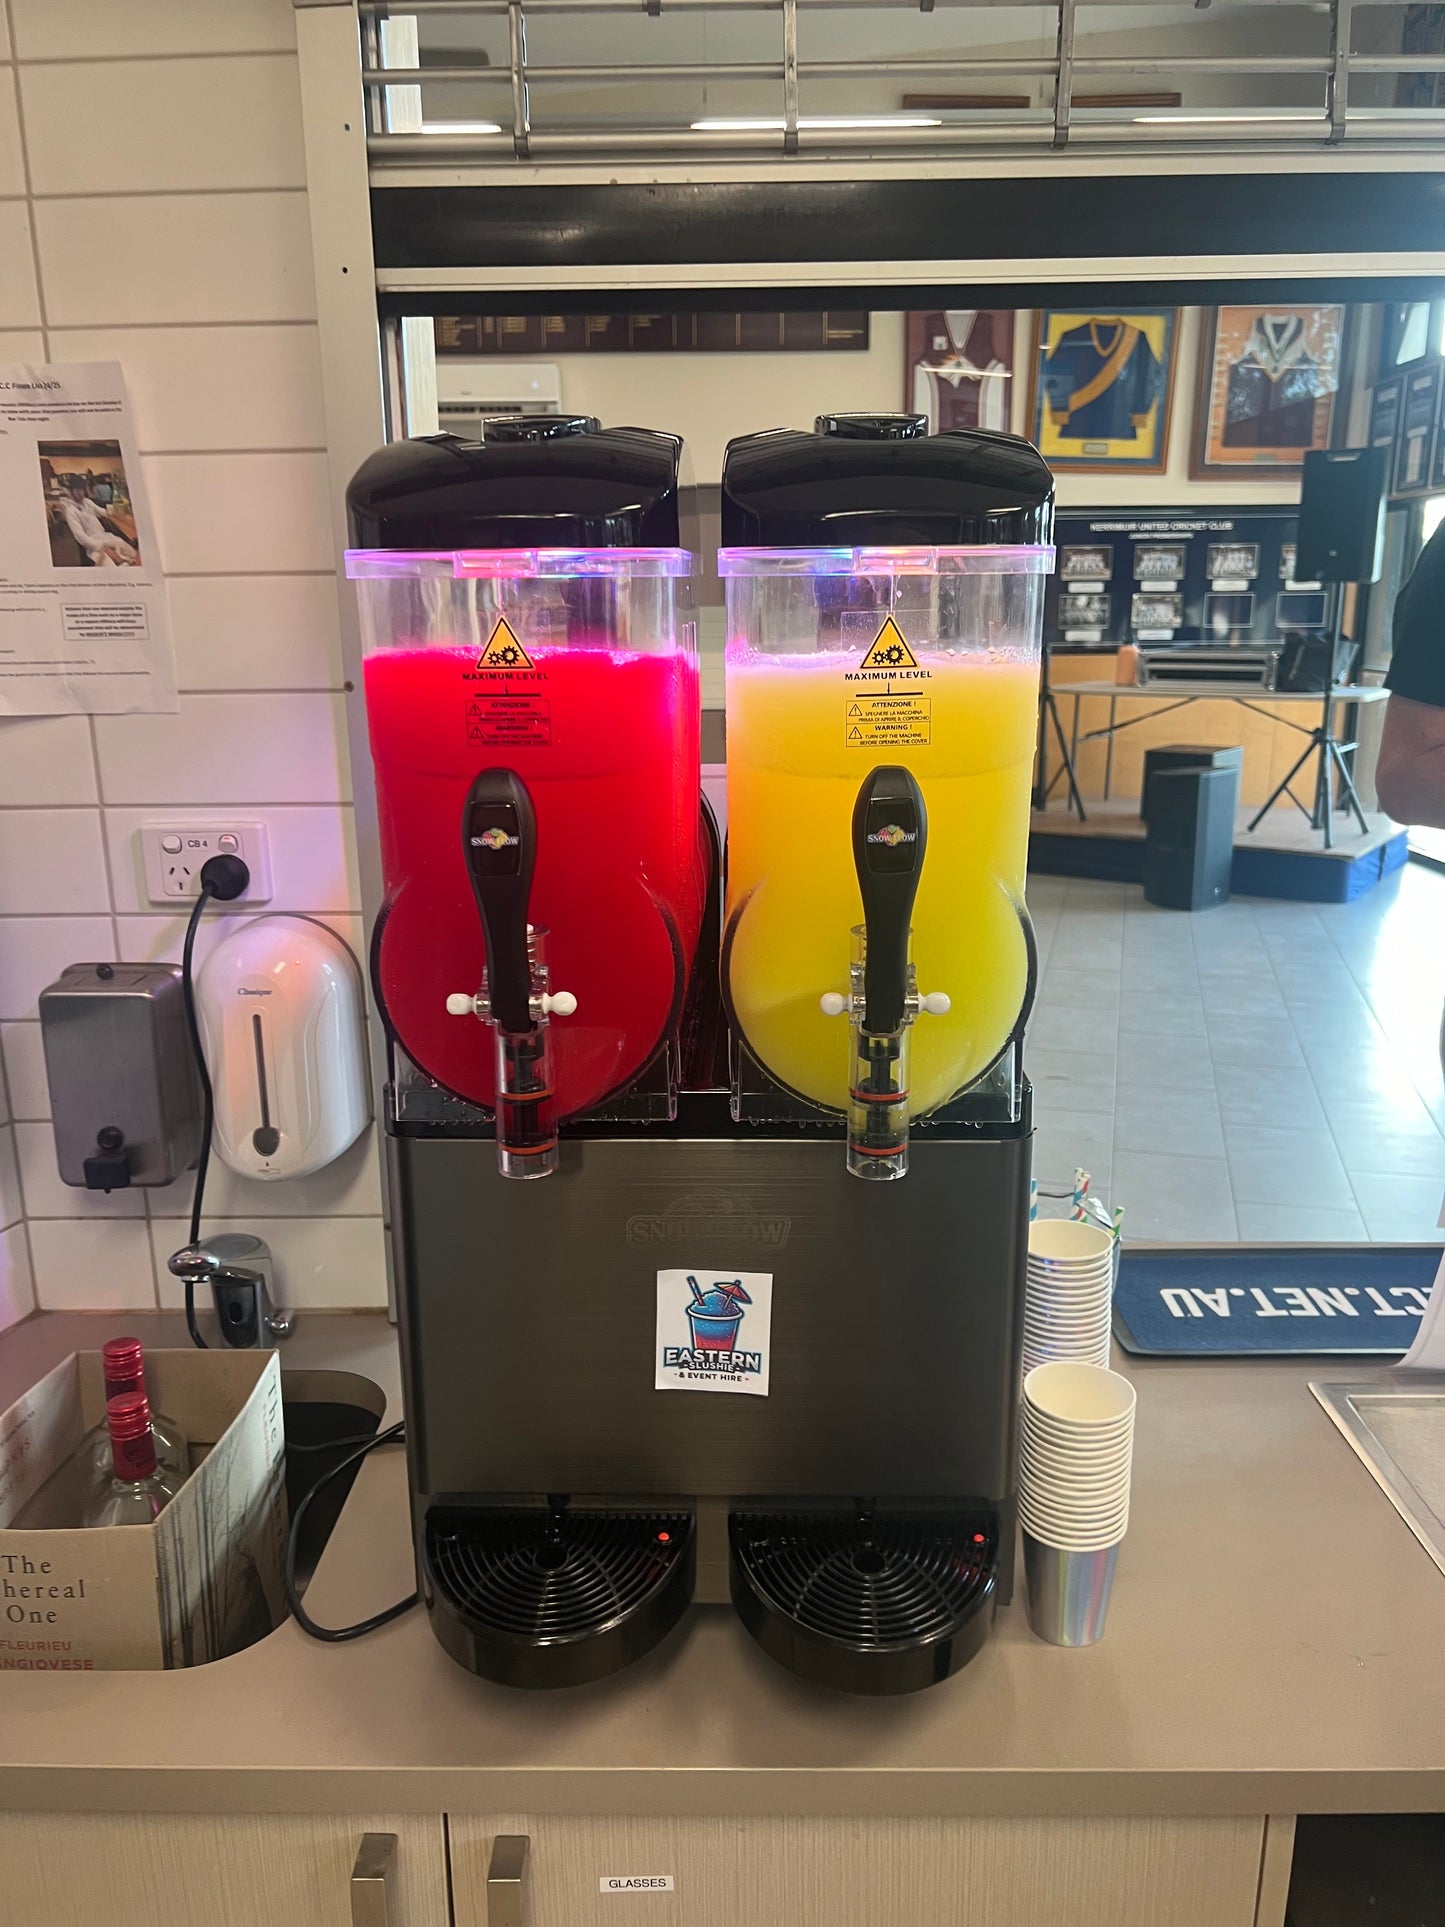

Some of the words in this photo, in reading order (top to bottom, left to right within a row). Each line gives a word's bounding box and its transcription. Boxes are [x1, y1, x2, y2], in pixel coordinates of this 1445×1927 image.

[1138, 521, 1169, 531] UNITED
[1209, 520, 1233, 530] CLUB
[844, 672, 897, 681] MAXIMUM
[900, 671, 933, 679] LEVEL
[867, 833, 916, 843] SNOWOW
[187, 840, 201, 848] CB
[1160, 1287, 1432, 1317] CT.NET.AU
[665, 1348, 760, 1371] EASTERN
[687, 1372, 718, 1380] EVENT
[720, 1374, 742, 1382] HIRE
[1, 1554, 52, 1574] The
[2, 1578, 86, 1599] hereal
[6, 1604, 58, 1624] One
[0, 1640, 72, 1651] FLEURIEU
[0, 1659, 94, 1670] NGIOVESE
[608, 1878, 667, 1889] GLASSES
